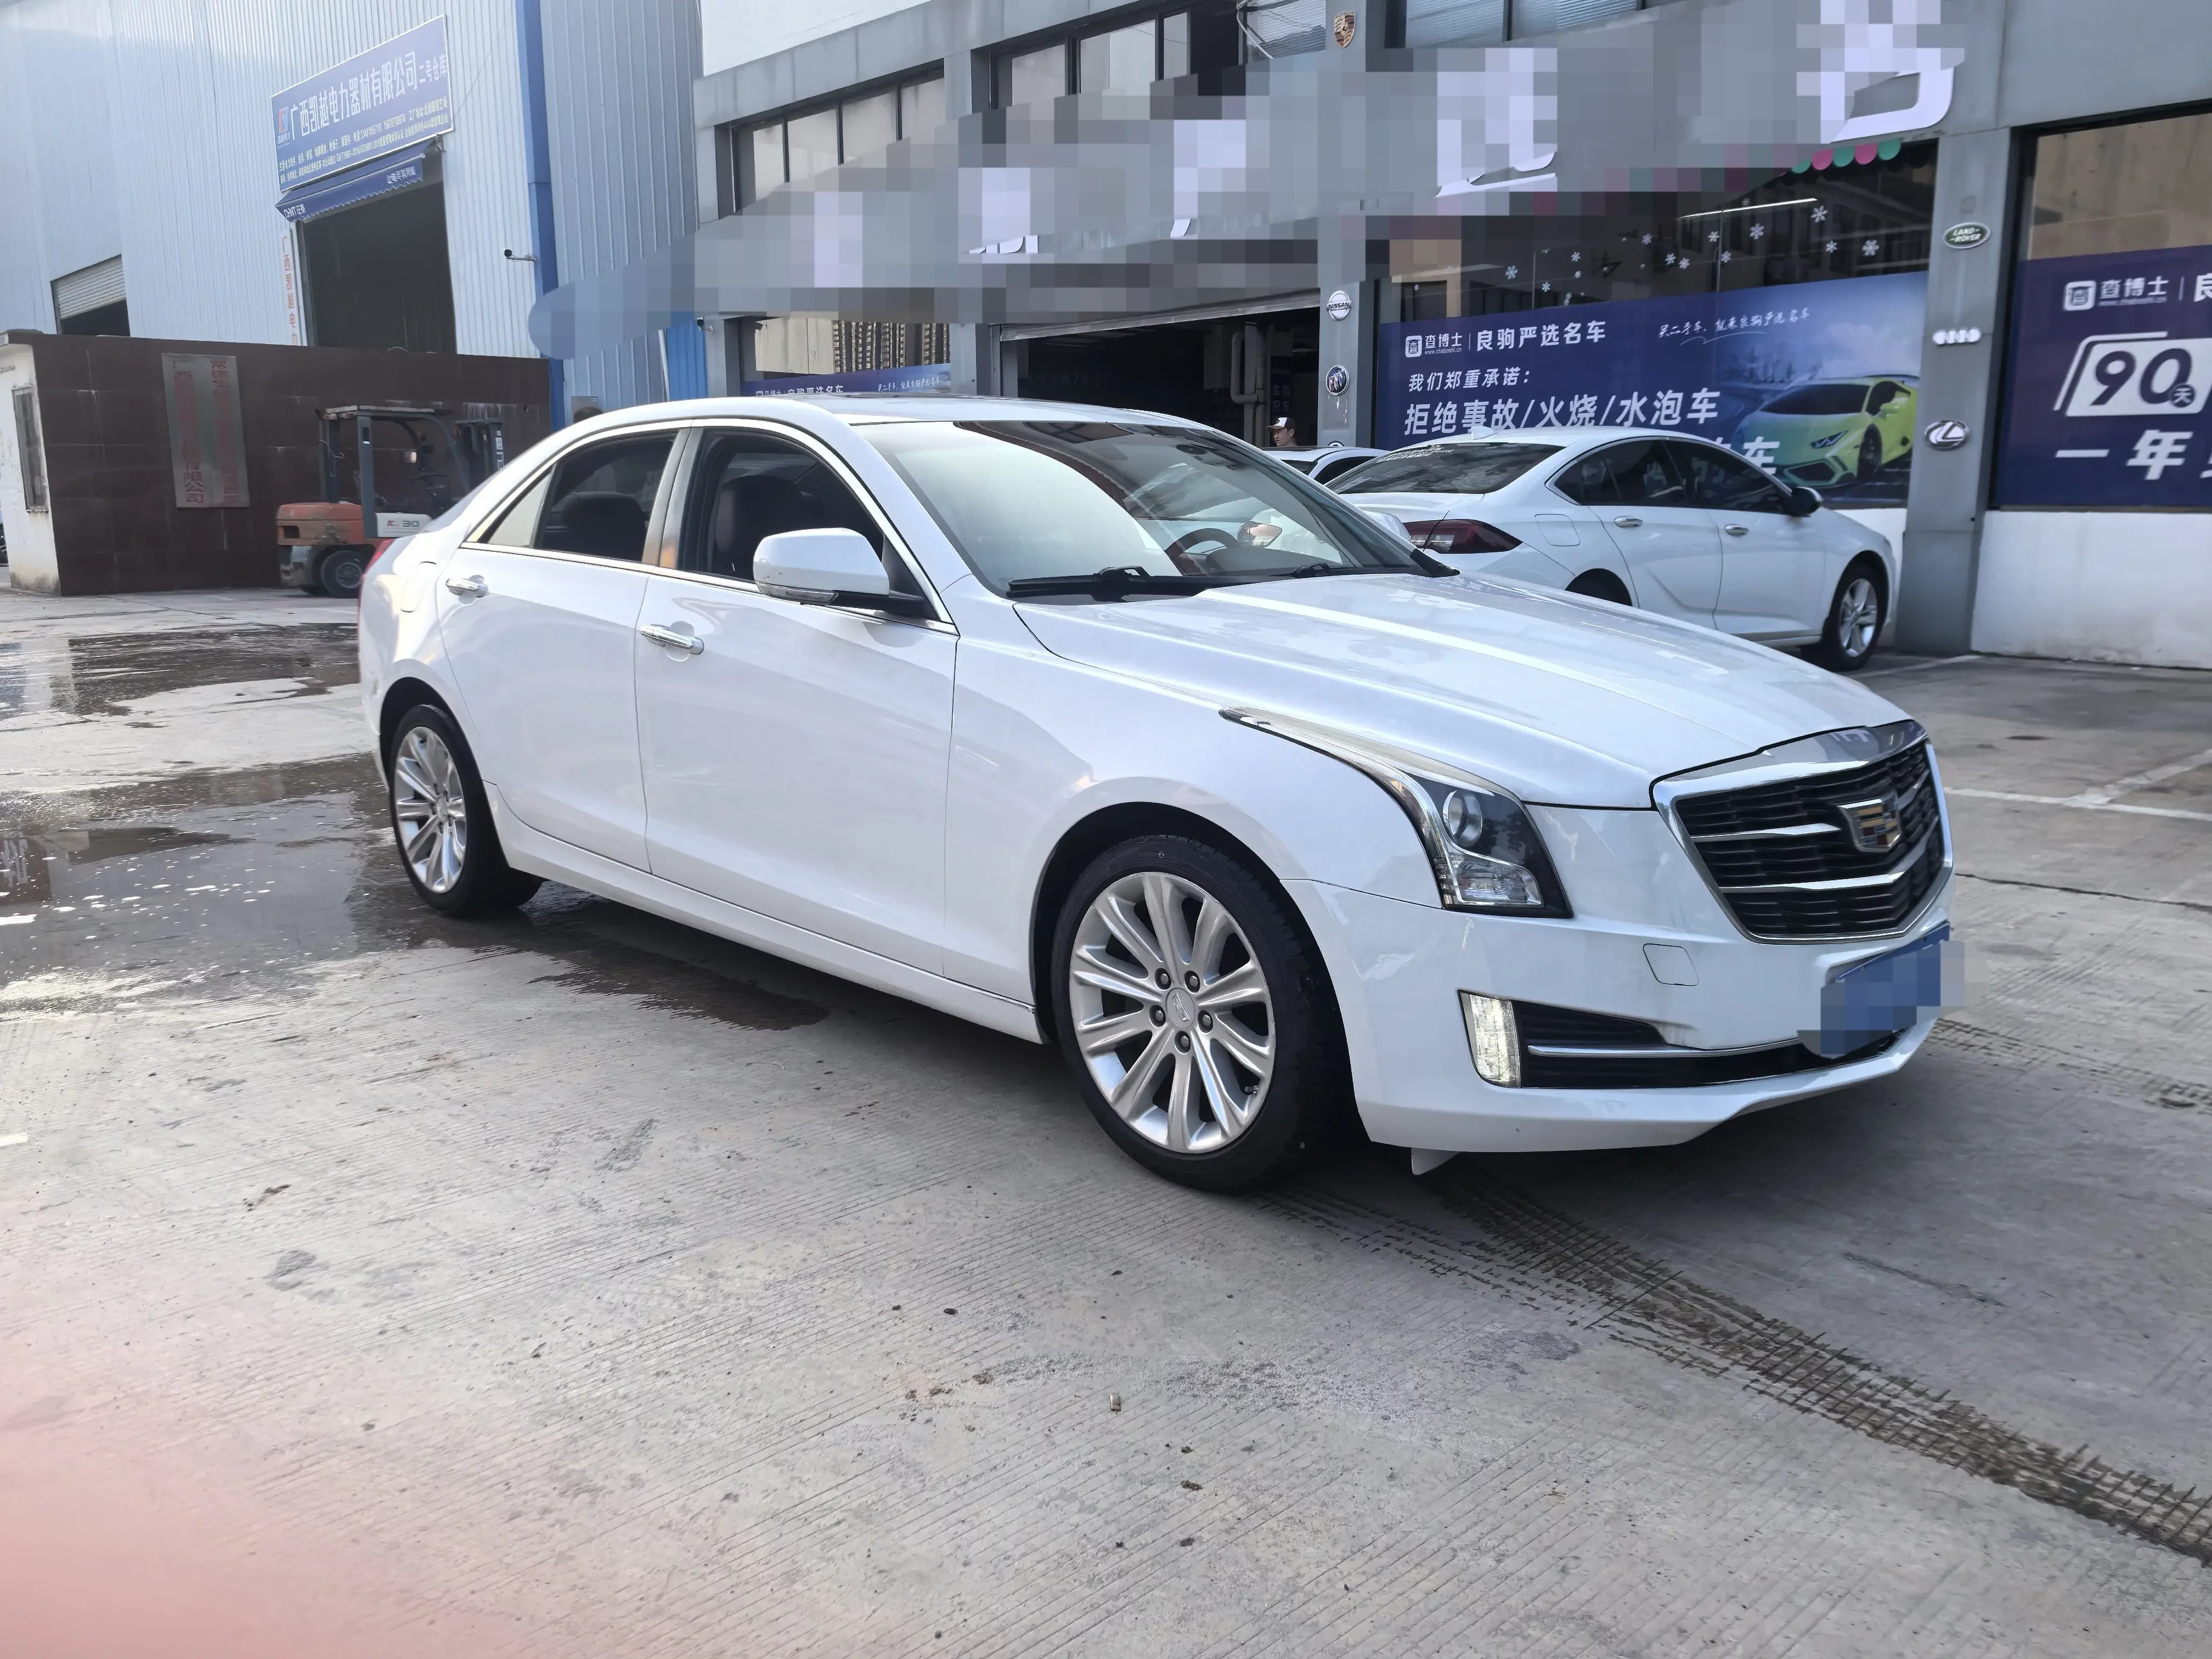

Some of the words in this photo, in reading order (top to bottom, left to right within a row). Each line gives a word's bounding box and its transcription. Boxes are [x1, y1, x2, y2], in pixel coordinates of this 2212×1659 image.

[1953, 227, 1976, 237] LAND
[1954, 233, 1981, 243] ROVER
[2100, 276, 2169, 300] 查博士
[1425, 332, 1463, 349] 查博士
[1476, 320, 1606, 352] 良驹严选名车
[2091, 348, 2193, 406] 90
[1404, 387, 1721, 435] 拒绝事故/火烧/水泡车
[2054, 429, 2212, 481] 一年
